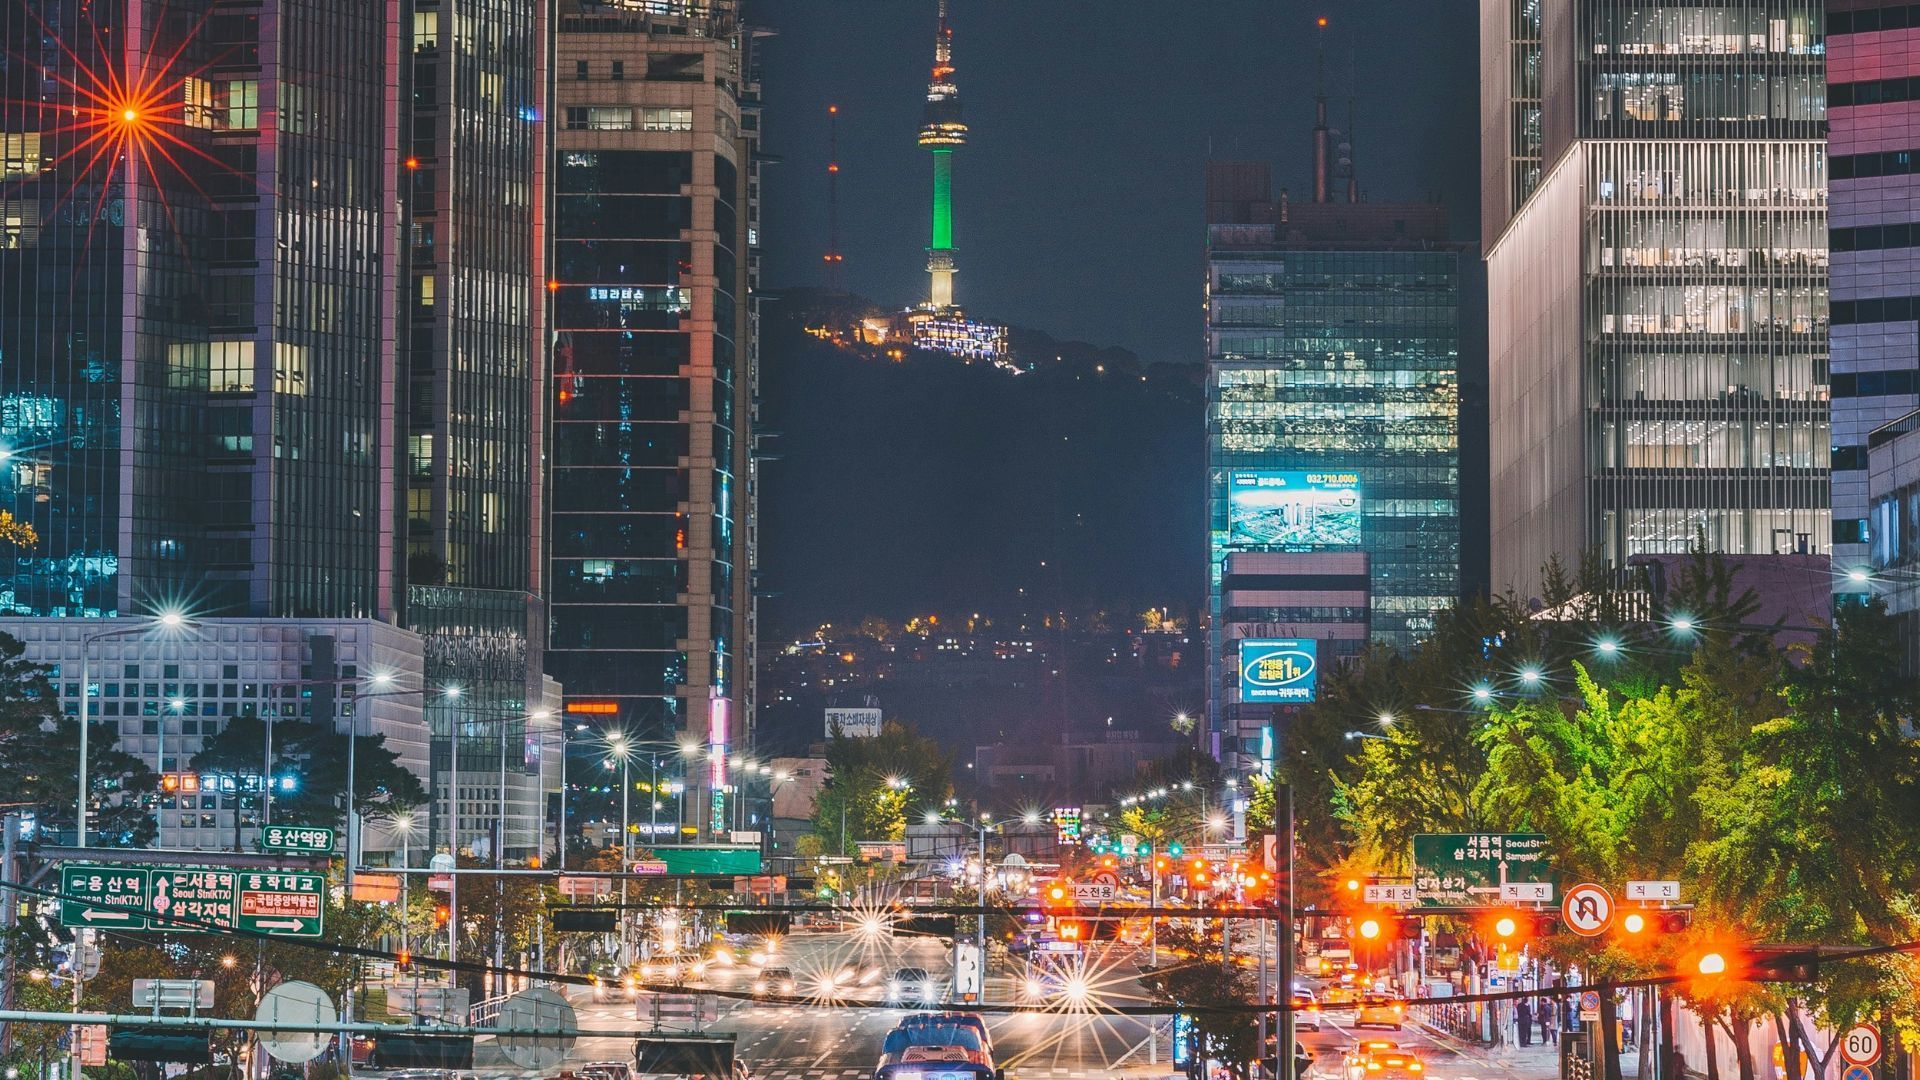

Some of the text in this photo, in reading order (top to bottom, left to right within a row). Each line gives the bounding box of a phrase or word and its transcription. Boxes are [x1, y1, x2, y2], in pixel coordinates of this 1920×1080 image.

[268, 829, 328, 848] 용산역앞
[1467, 836, 1502, 848] 서울역
[1505, 840, 1530, 848] Seoul
[1454, 848, 1502, 860] 삼각지역
[88, 875, 140, 893] 용산역
[189, 873, 232, 890] 서울역
[248, 875, 314, 891] 동작대교
[1417, 877, 1466, 890] 전자상가
[172, 888, 231, 899] Seoul Stn(KTX)
[1067, 886, 1112, 898] 버스전용
[1369, 887, 1412, 900] 좌회전
[1508, 886, 1545, 898] 직진
[1635, 885, 1672, 896] 직진
[104, 893, 143, 906] Stn(KTX)
[256, 894, 317, 908] 국립중앙박물관
[172, 901, 231, 918] 삼각지역
[1850, 1035, 1872, 1053] 60
